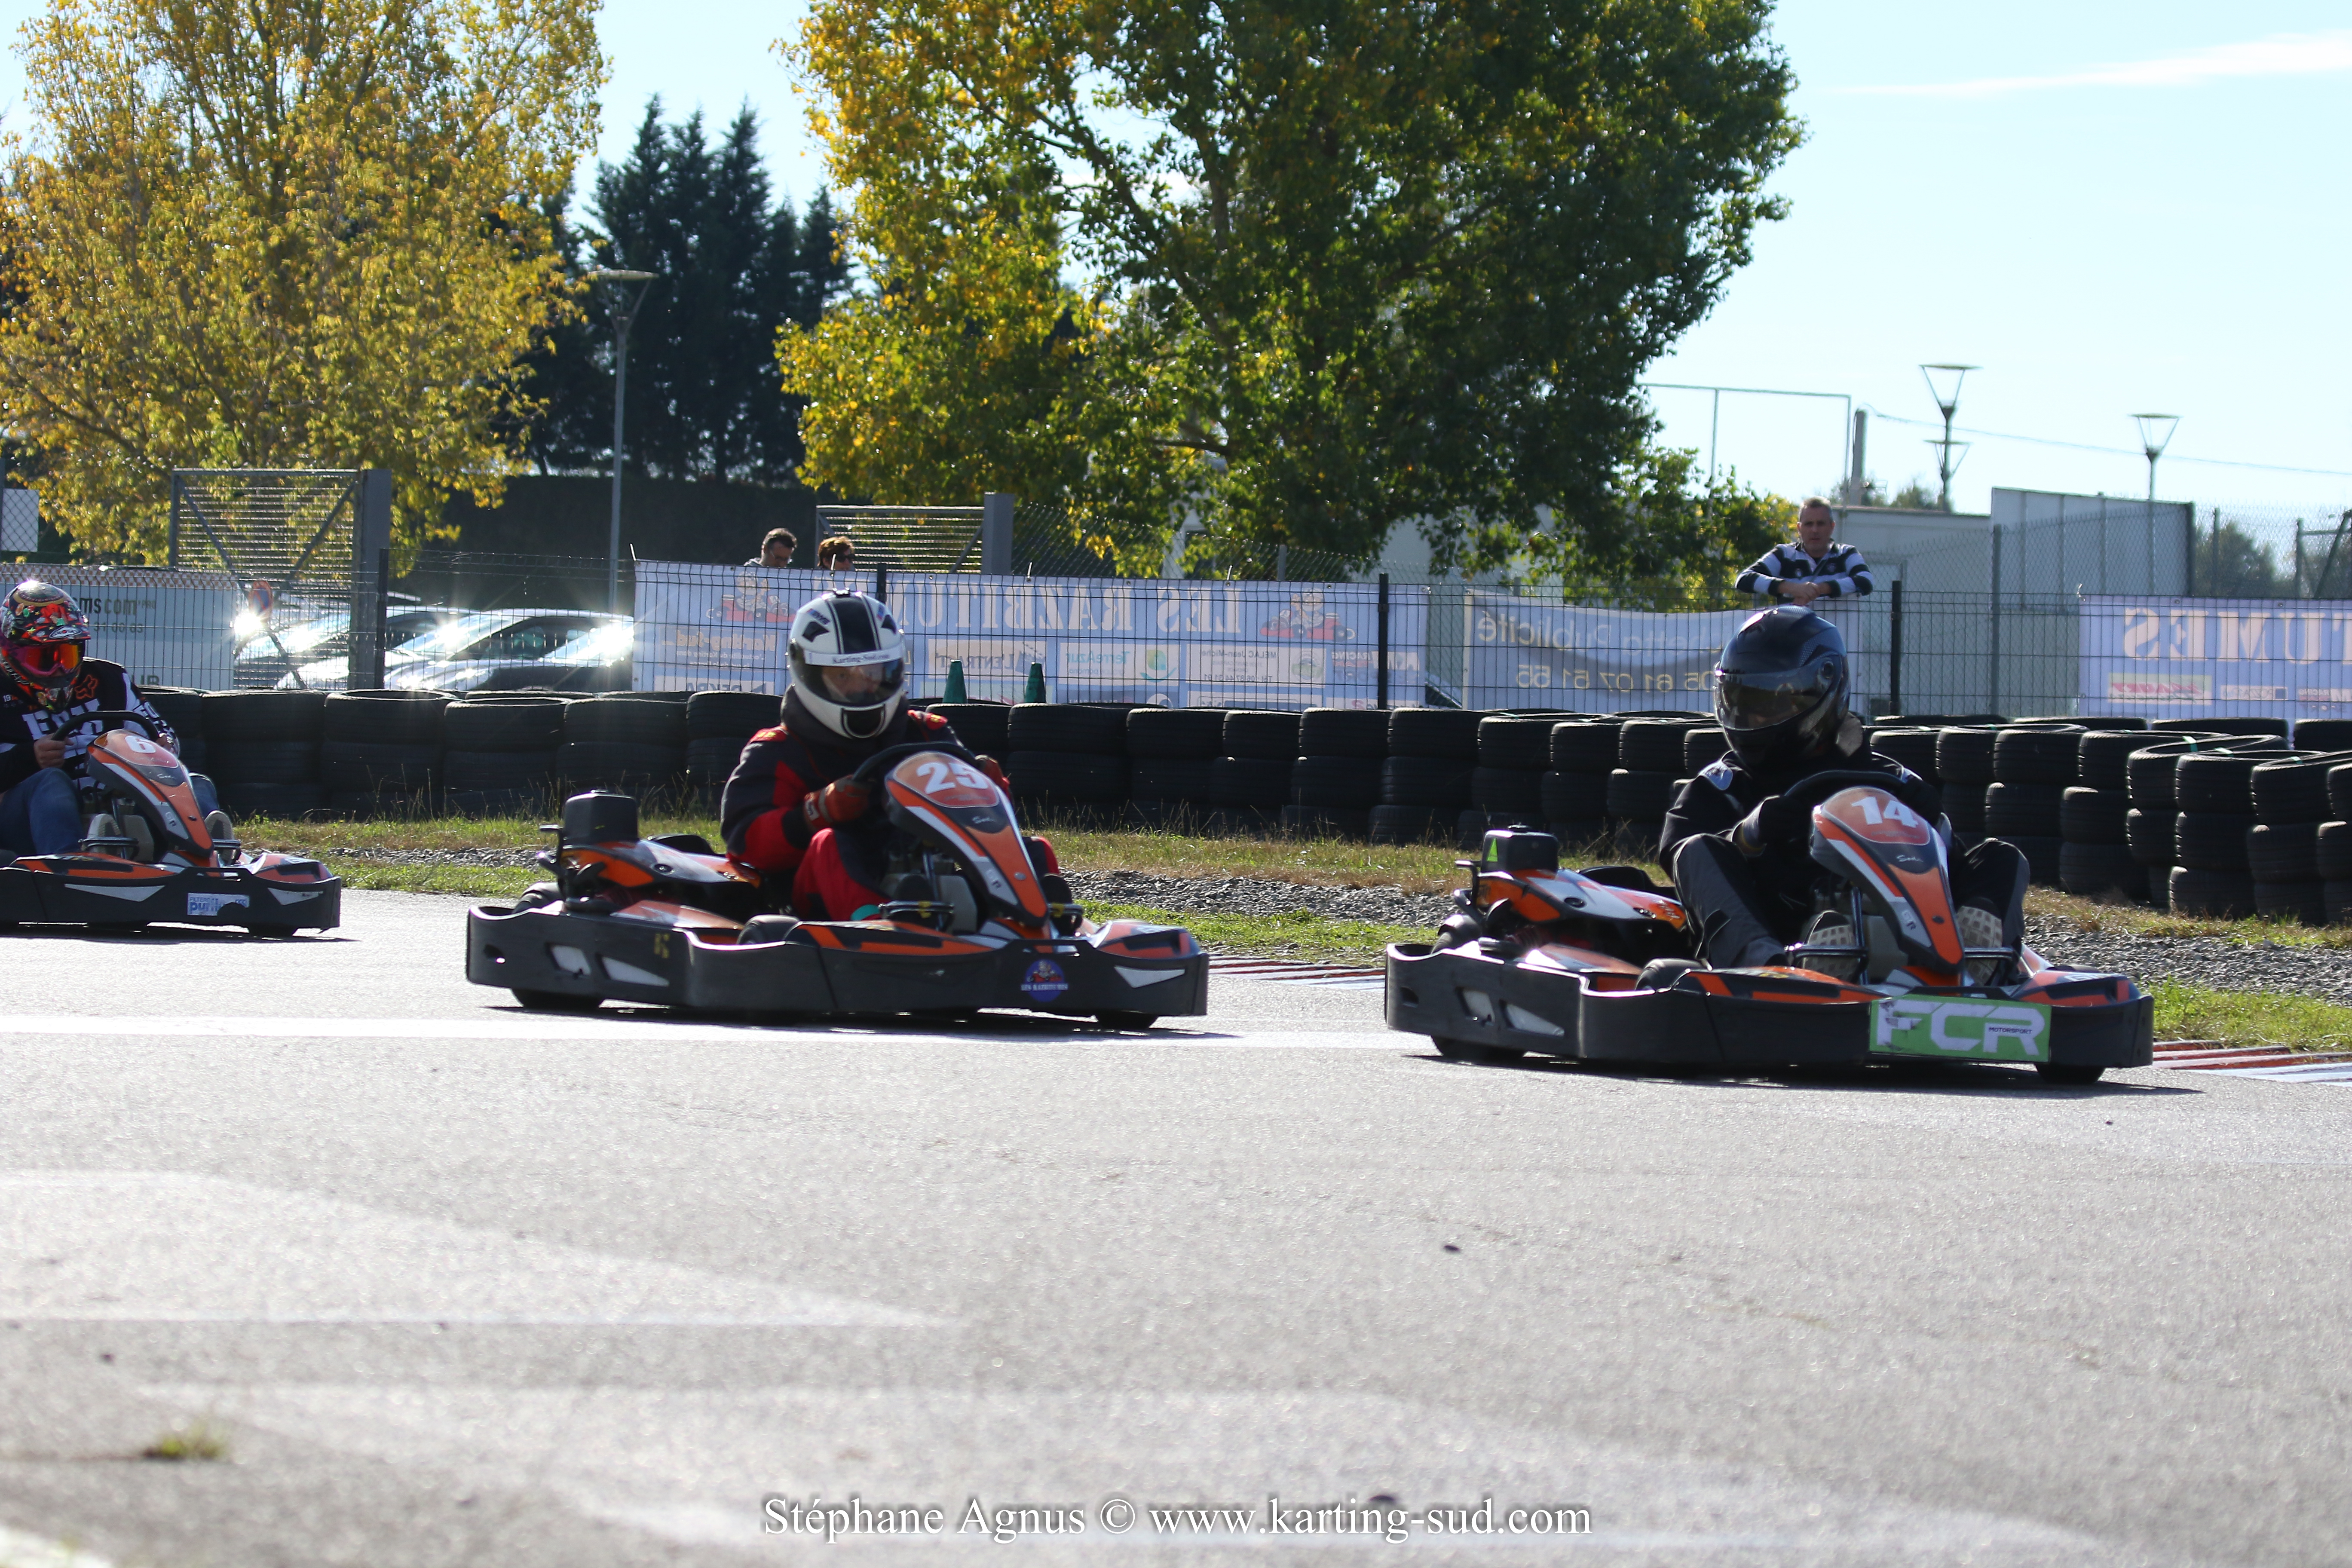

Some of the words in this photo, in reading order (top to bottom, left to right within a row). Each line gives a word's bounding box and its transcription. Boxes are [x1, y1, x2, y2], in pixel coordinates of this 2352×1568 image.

[125, 735, 156, 753] 6
[916, 762, 989, 795] 25
[1851, 796, 1919, 828] 14
[1877, 999, 2046, 1056] FCR
[1989, 1026, 2033, 1035] MOTORSPORT
